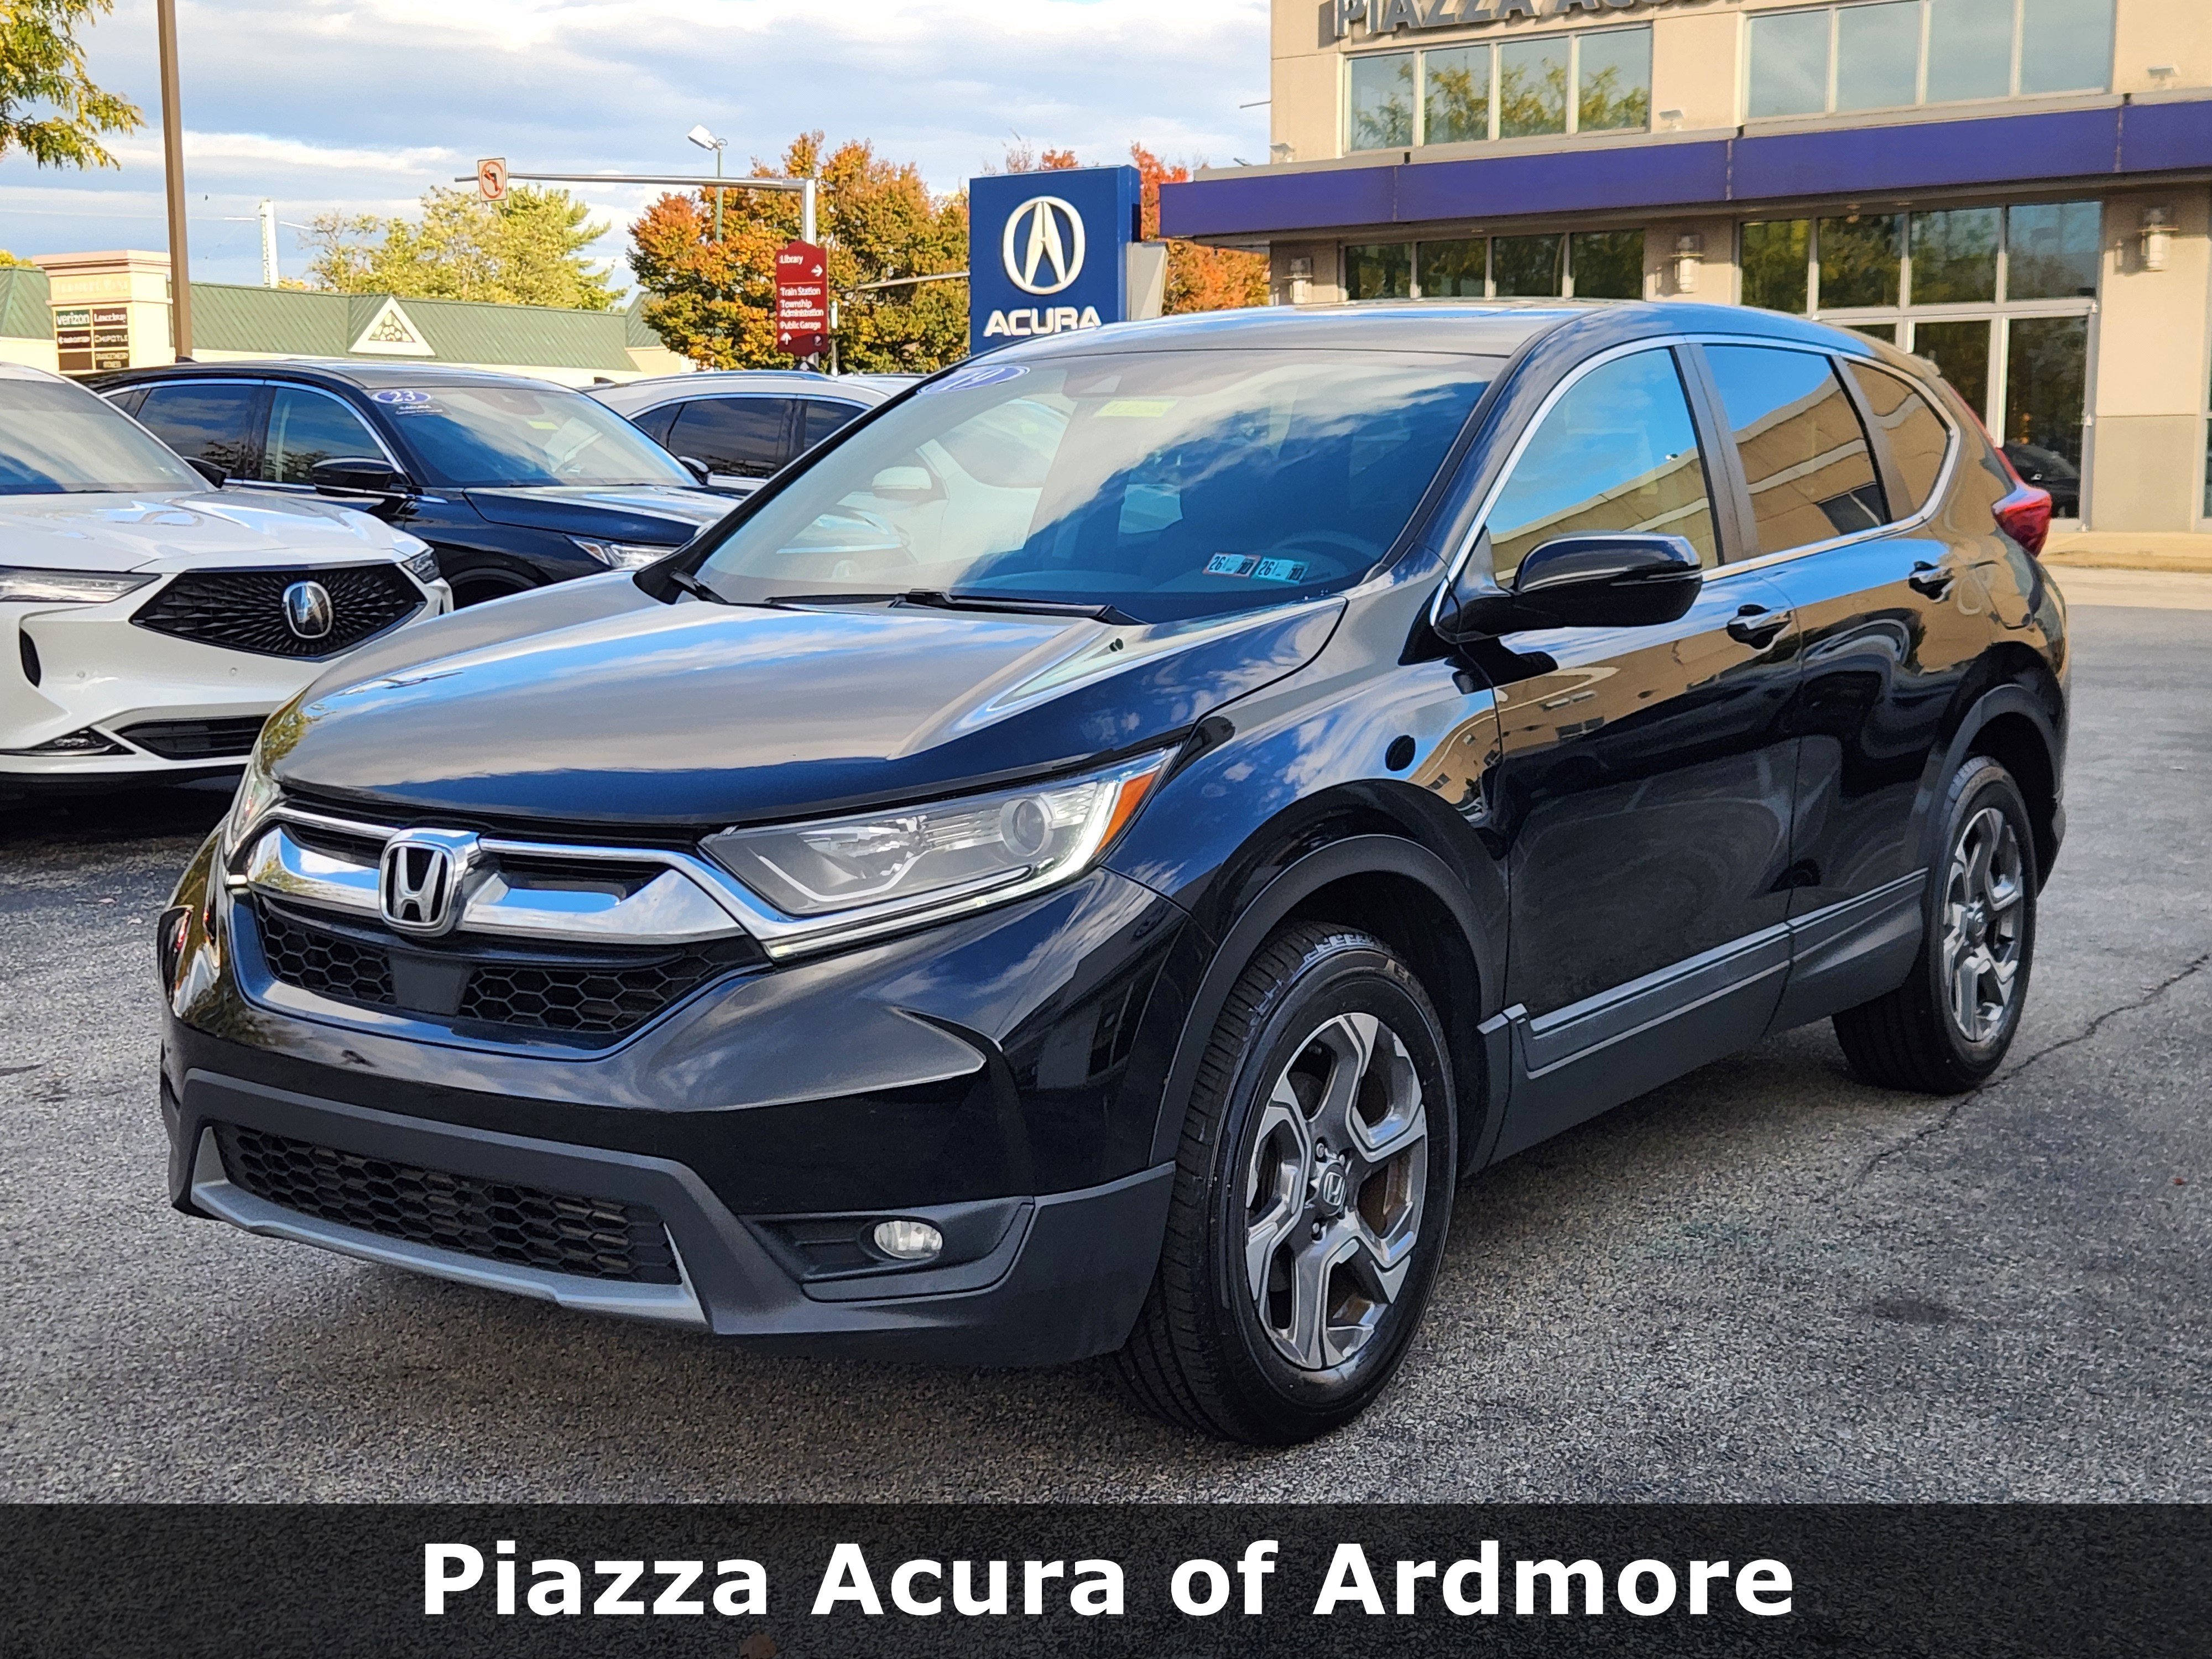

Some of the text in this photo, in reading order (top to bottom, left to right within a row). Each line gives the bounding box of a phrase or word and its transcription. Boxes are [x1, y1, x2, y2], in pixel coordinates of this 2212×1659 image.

[779, 254, 803, 265] Library
[780, 286, 821, 296] Train Station
[780, 299, 812, 309] Township
[56, 312, 90, 325] verizon
[983, 306, 1102, 337] ACURA
[780, 321, 821, 330] Public Garage
[389, 389, 416, 403] 23
[1209, 556, 1254, 575] 26 10
[1258, 561, 1304, 581] 26 10
